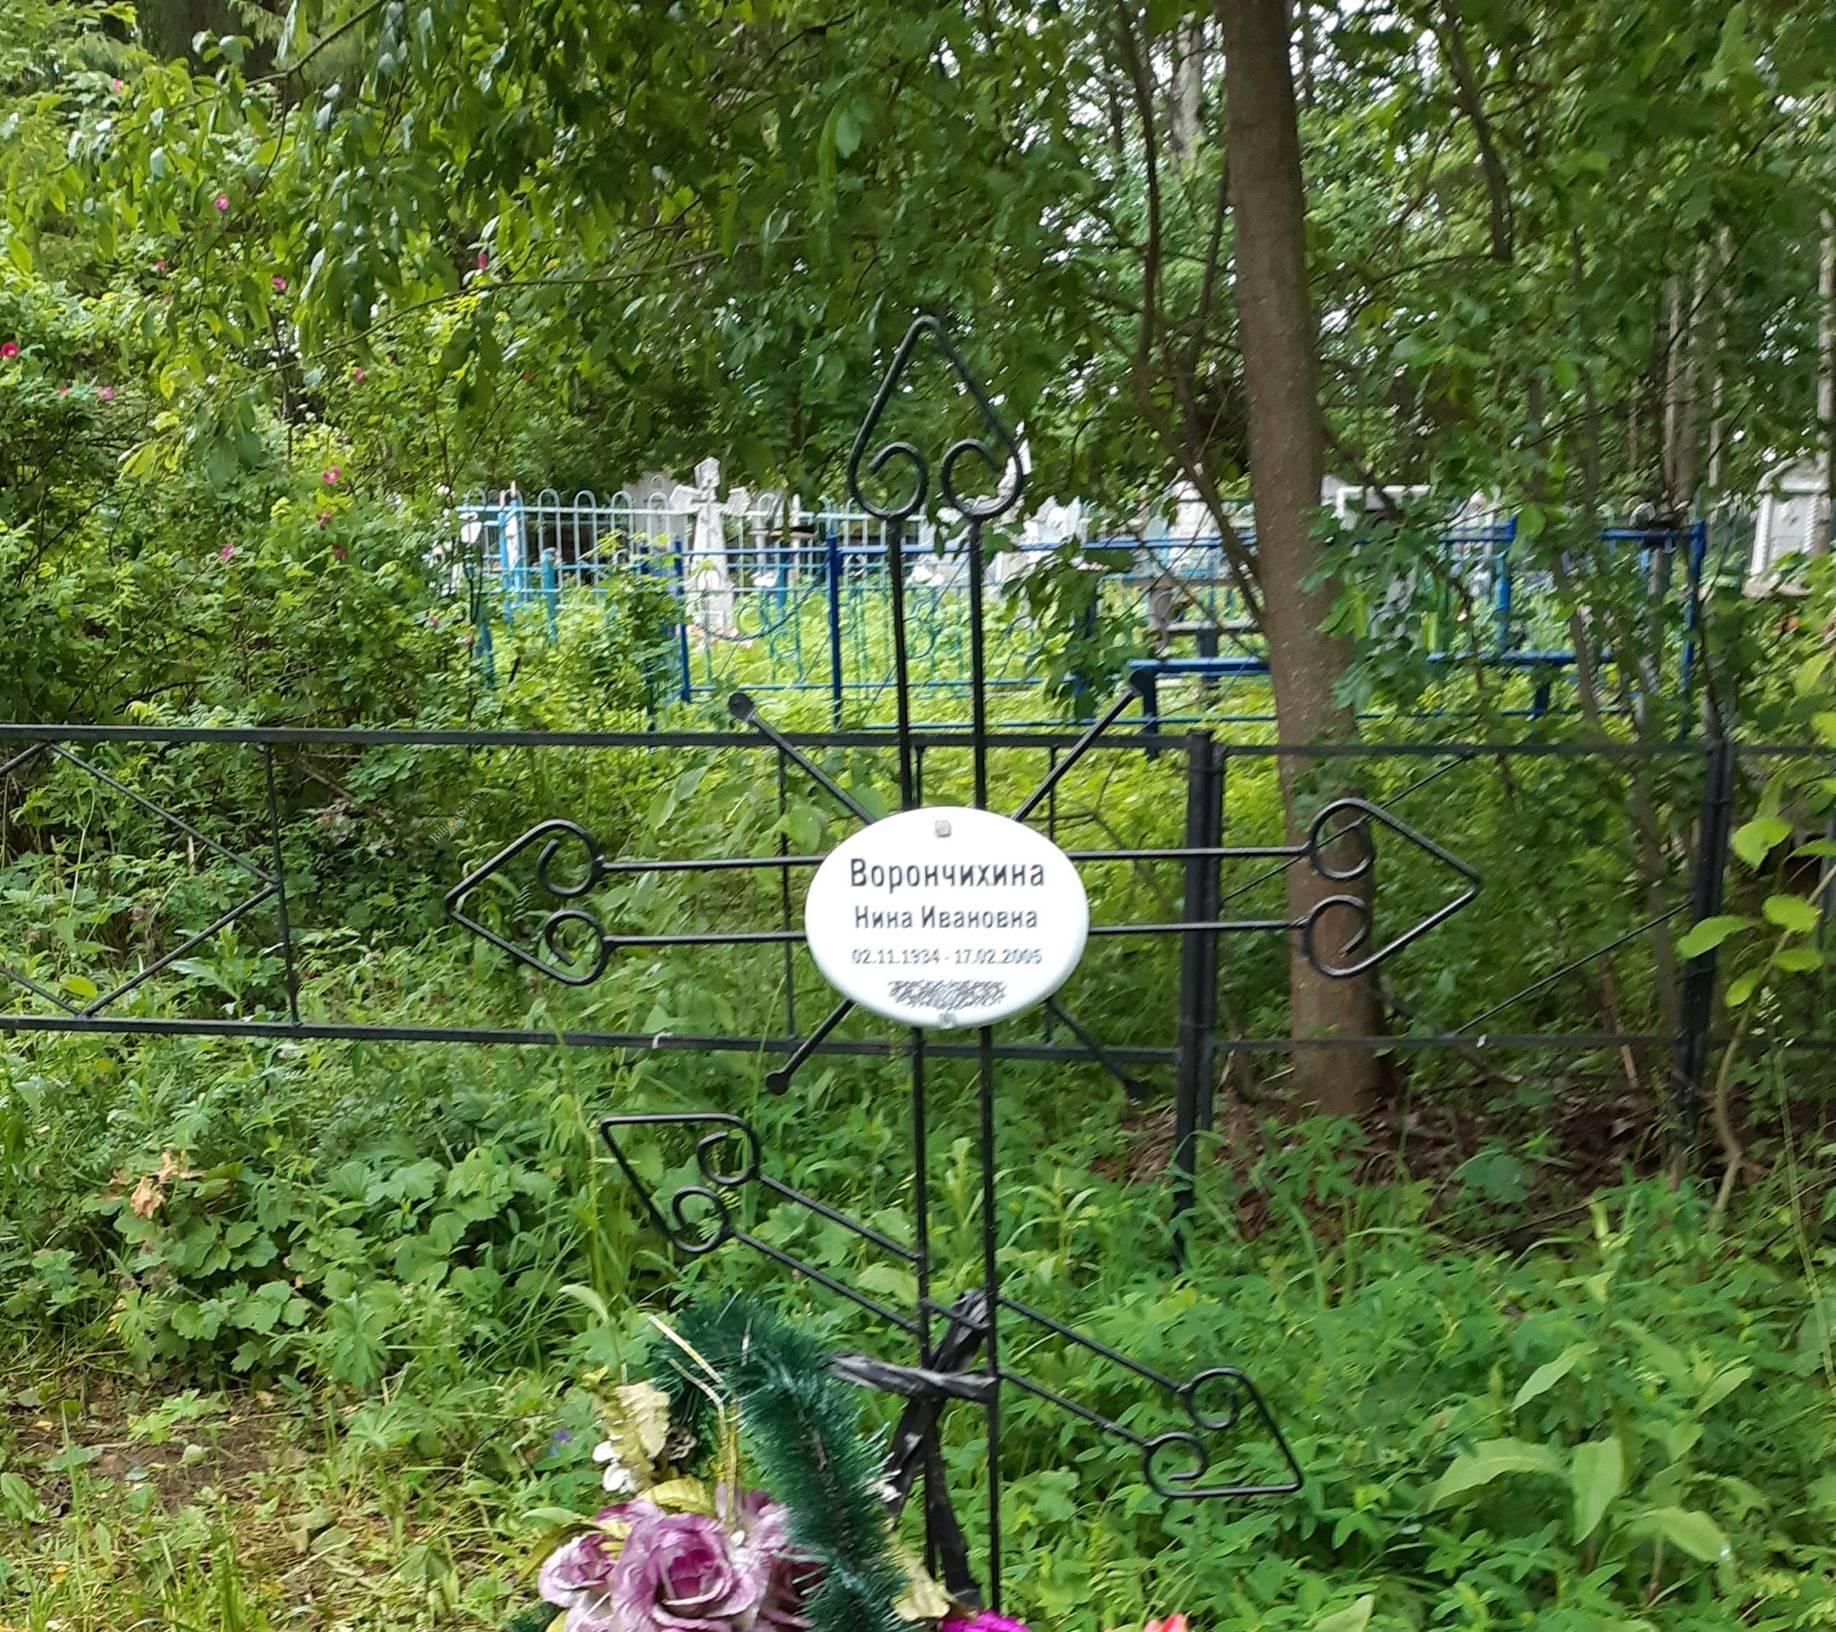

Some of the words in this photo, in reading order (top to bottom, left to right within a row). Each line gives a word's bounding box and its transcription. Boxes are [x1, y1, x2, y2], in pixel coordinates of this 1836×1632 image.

[850, 857, 1045, 894] Ворончихина
[855, 905, 913, 929] Нина
[921, 905, 1039, 929] Ивановна
